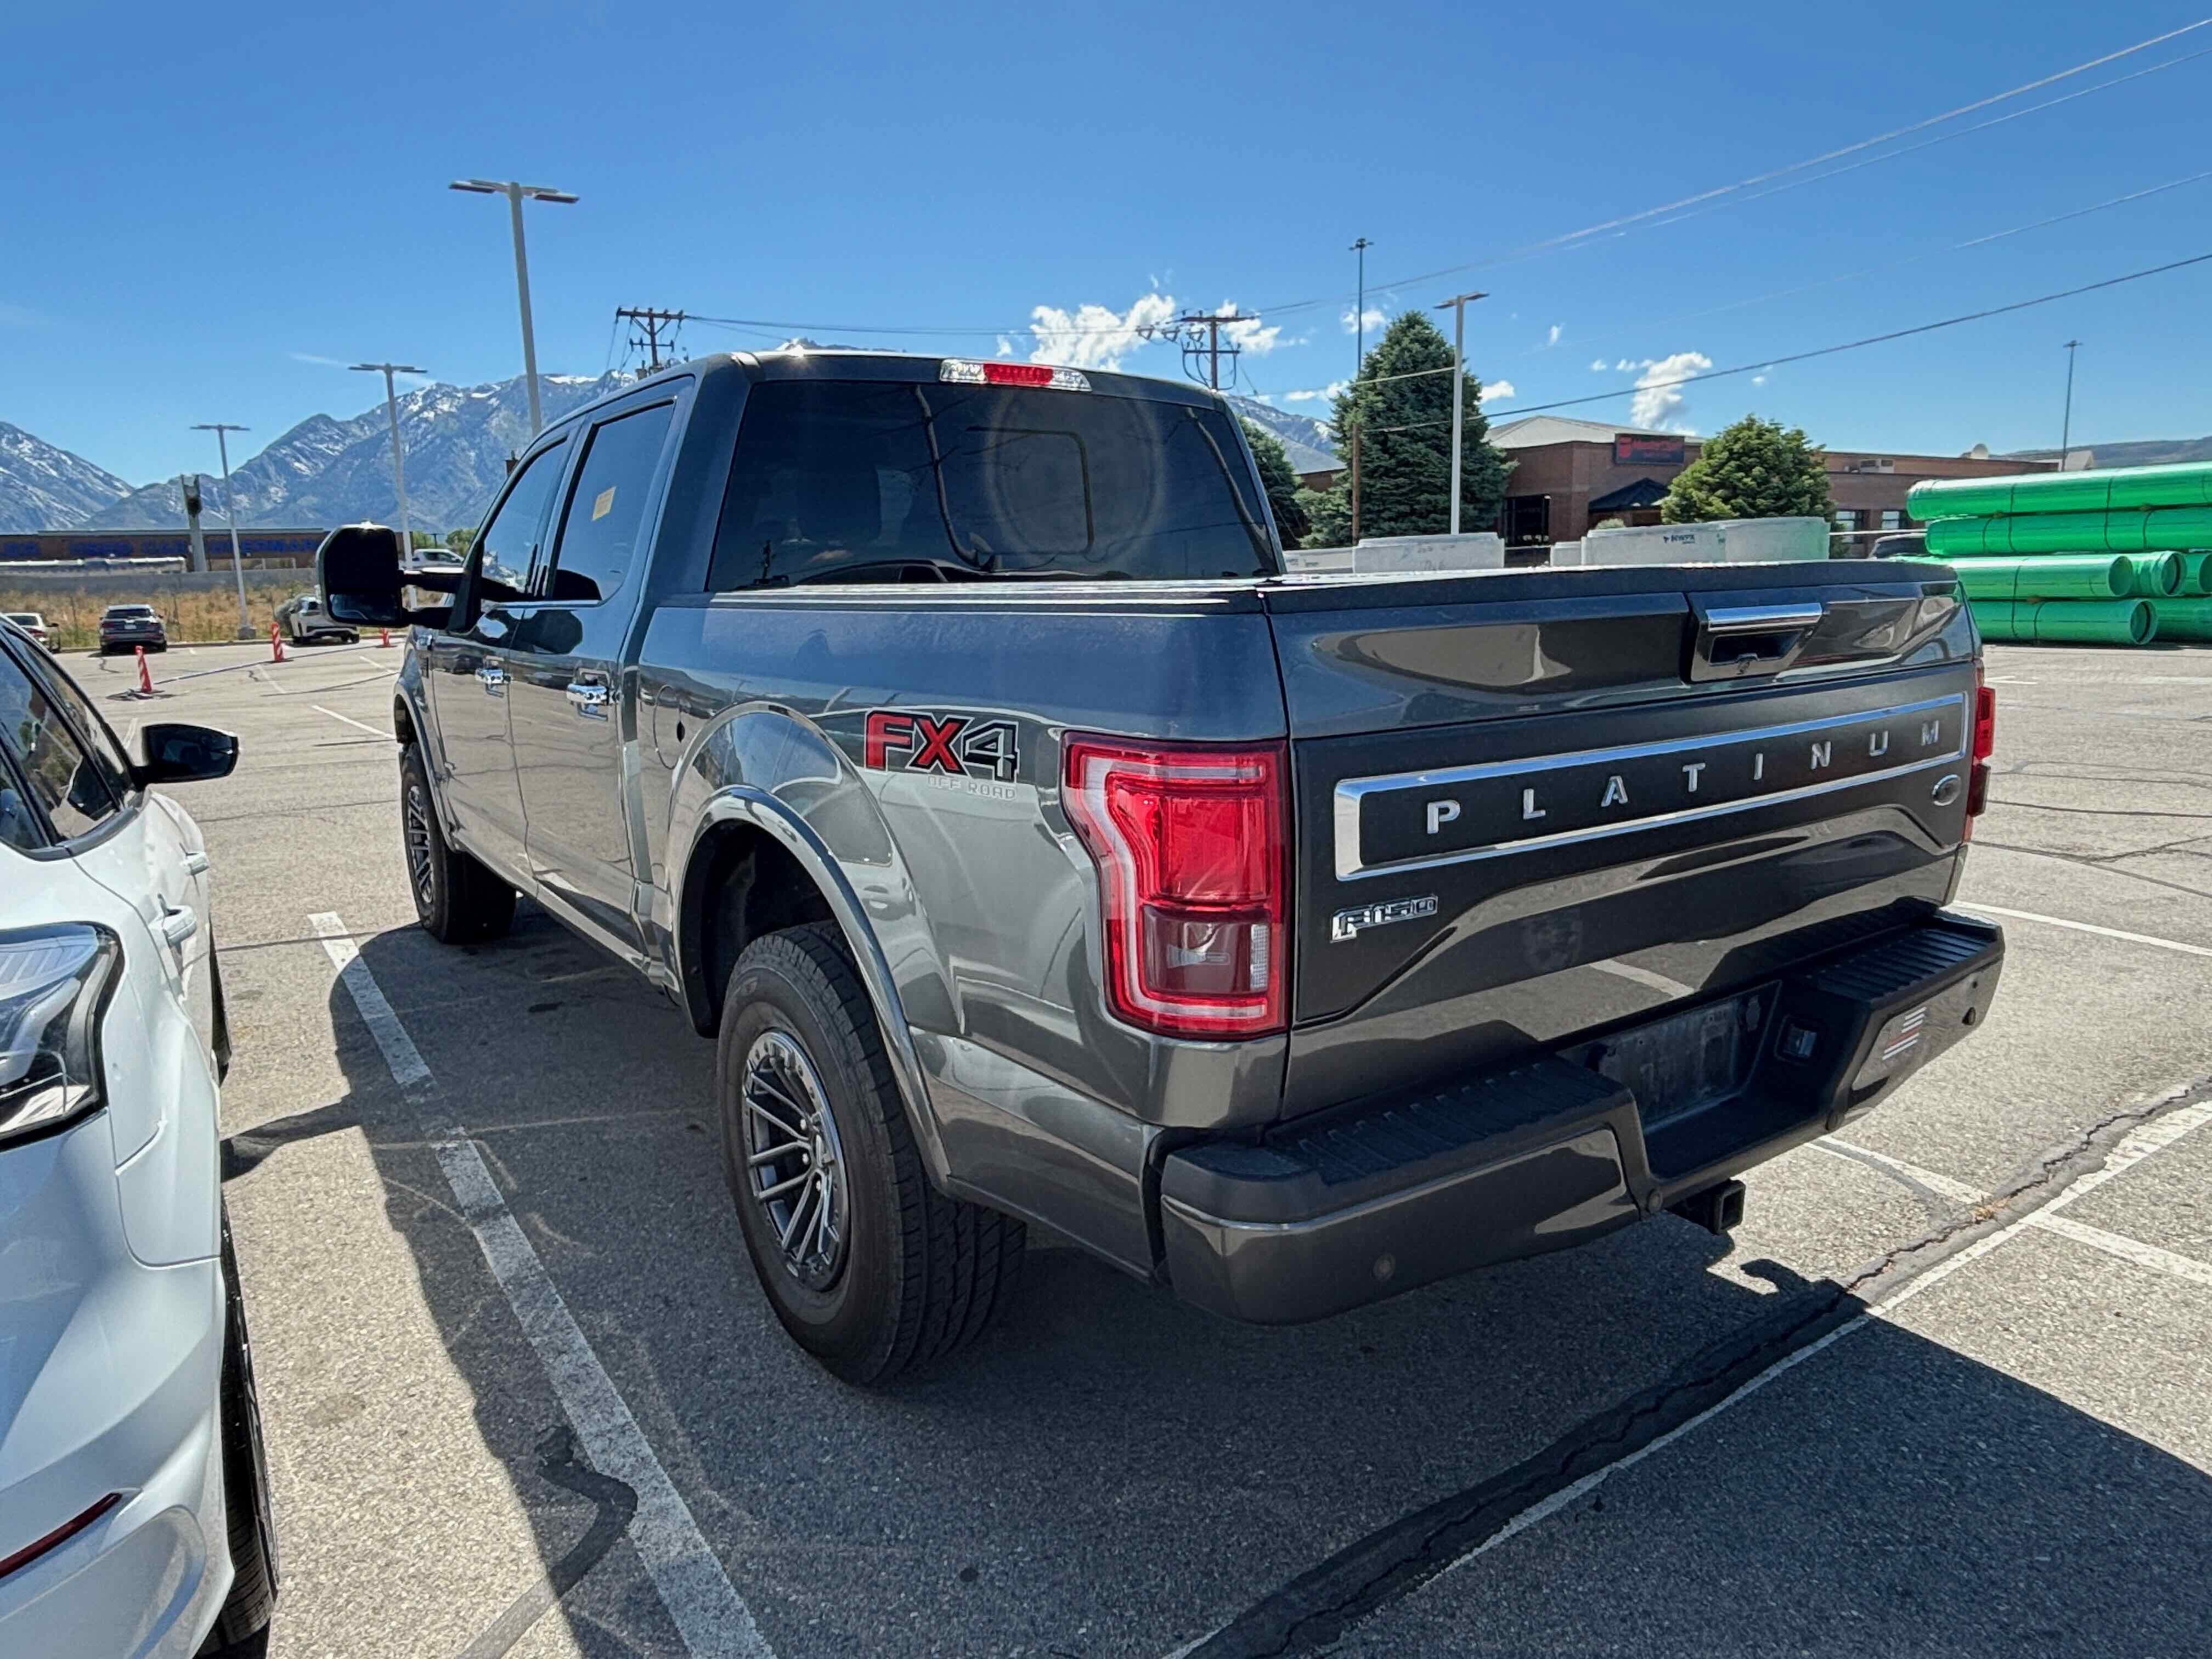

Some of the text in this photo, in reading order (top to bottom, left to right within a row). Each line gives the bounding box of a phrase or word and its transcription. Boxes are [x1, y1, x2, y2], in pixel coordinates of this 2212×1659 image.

[865, 710, 1020, 783] FX4
[1426, 719, 1940, 834] PLATINUM
[927, 775, 1016, 801] OFF ROAD
